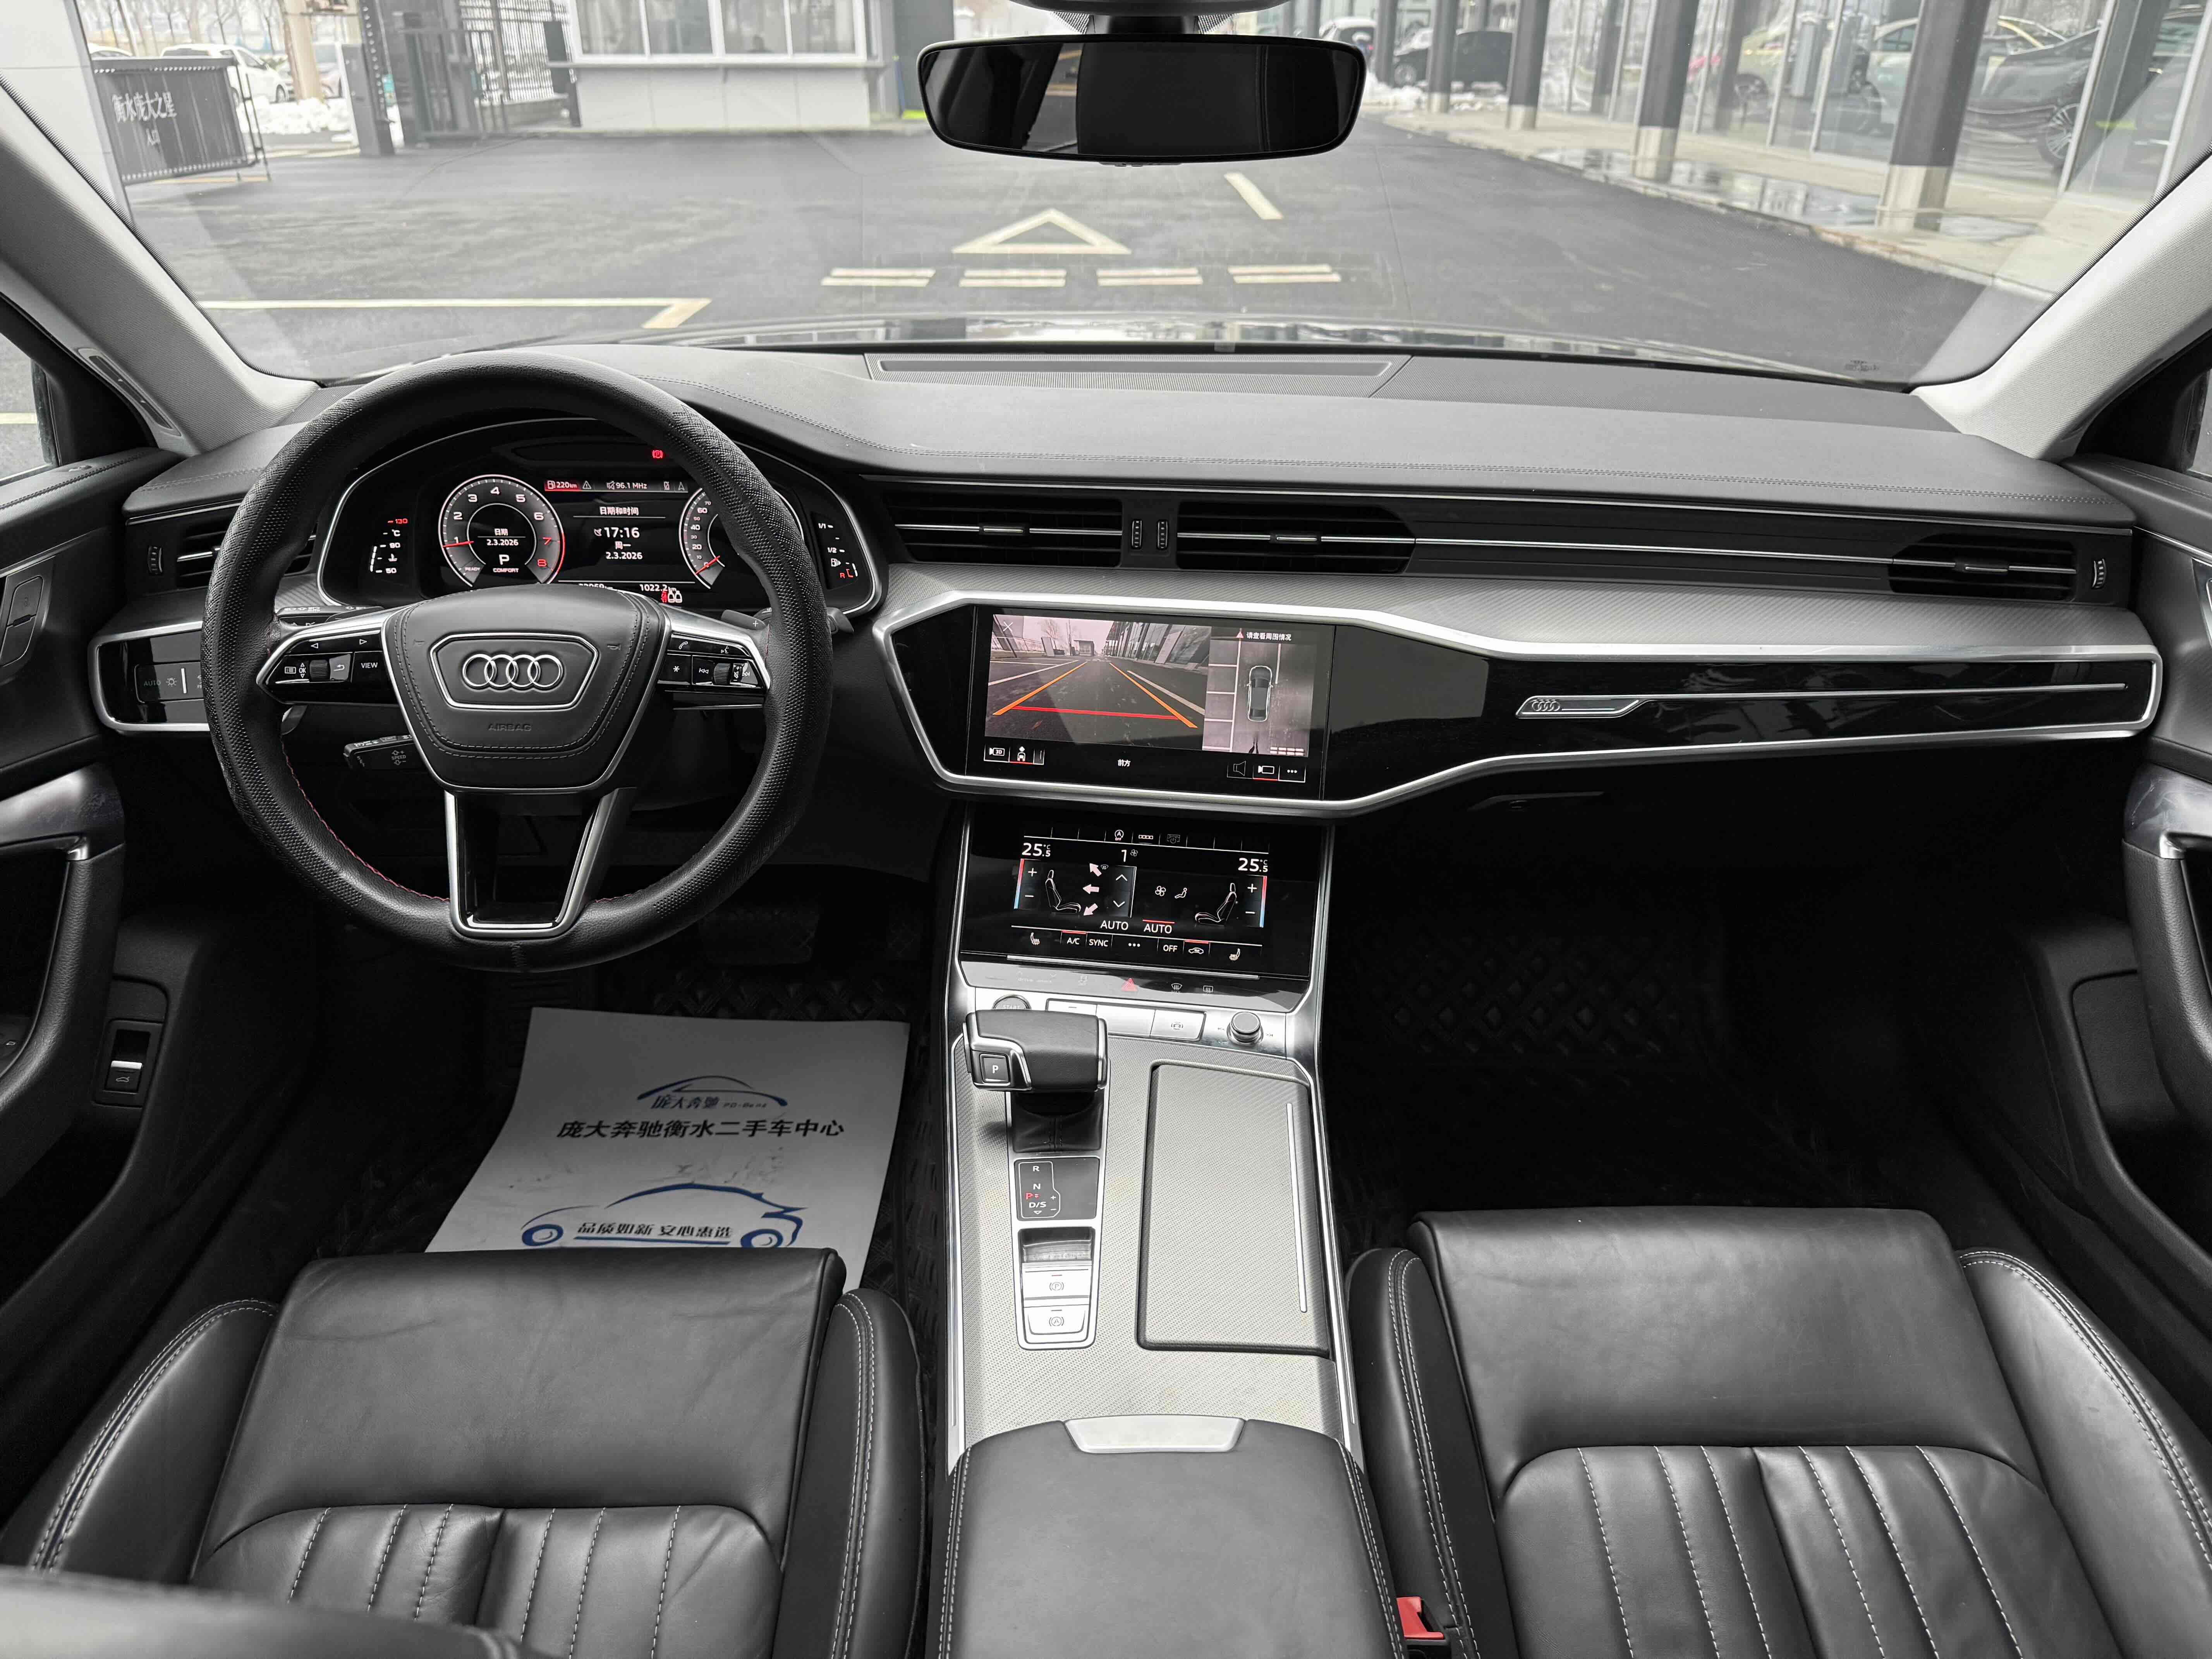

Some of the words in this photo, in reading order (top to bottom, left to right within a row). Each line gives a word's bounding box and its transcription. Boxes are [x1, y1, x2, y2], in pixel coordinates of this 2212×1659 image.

[490, 486, 500, 495] 4
[468, 494, 477, 502] 3
[516, 494, 526, 502] 5
[600, 507, 639, 515] 日期和时间
[453, 512, 463, 520] 2
[534, 512, 544, 520] 6
[604, 527, 640, 538] 17:16
[615, 541, 631, 550] 周一
[499, 554, 510, 565] P
[606, 551, 643, 560] 2.3.2026
[1246, 631, 1292, 641] 请查看周围情况
[488, 723, 532, 732] AIRBAG
[1118, 759, 1131, 767] 前方
[1121, 849, 1127, 862] 1
[1100, 920, 1129, 931] AUTO
[1143, 924, 1172, 934] AUTO
[1066, 937, 1080, 946] A/C
[1089, 938, 1109, 947] SYNC
[1163, 944, 1178, 953] OFF
[992, 1065, 999, 1074] P
[556, 1119, 845, 1138] 庞大奔驰衡水二手车中心
[577, 1222, 654, 1235] 品质如新
[658, 1224, 732, 1238] 安心惠选
